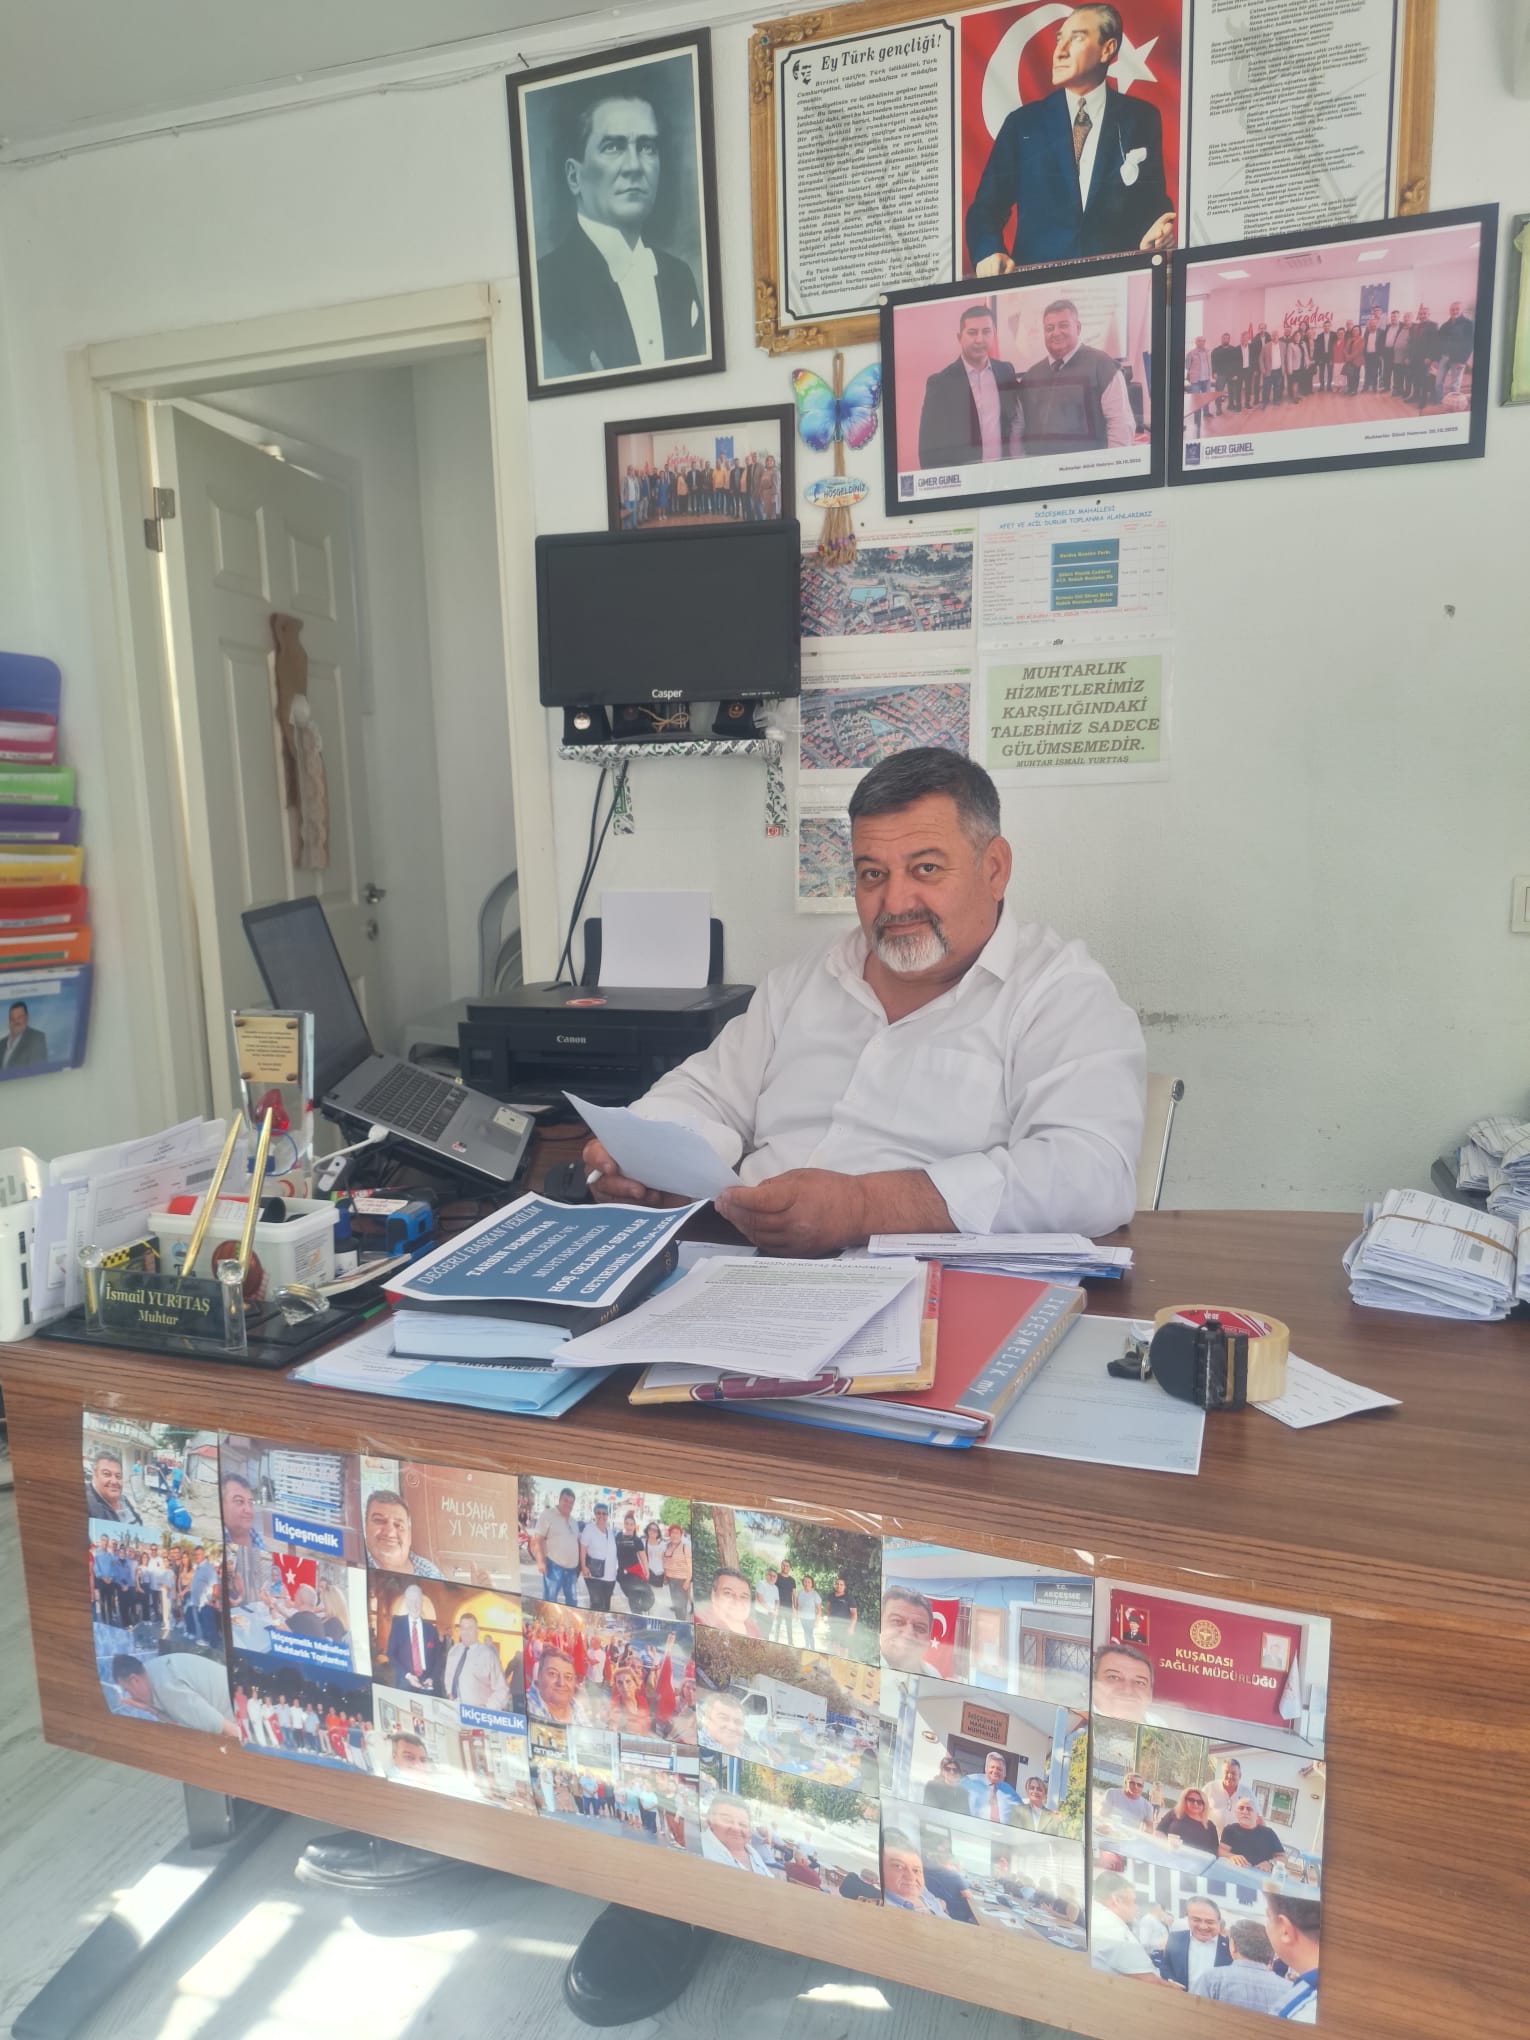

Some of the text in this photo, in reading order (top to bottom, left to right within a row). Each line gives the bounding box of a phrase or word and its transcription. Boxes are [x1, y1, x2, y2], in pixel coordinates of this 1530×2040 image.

[821, 34, 942, 72] Ey Türk gençliği!
[1022, 661, 1128, 680] MUHTARLIK
[651, 689, 683, 700] Casper
[1004, 677, 1146, 700] HİZMETLERİMİZ
[1002, 696, 1148, 720] KARŞILIĞINDAKİ
[991, 718, 1160, 738] TALEBİMİZ SADECE
[1002, 735, 1145, 757] GÜLÜMSEMEDİR.
[1016, 759, 1055, 768] MUHTAR
[556, 1034, 587, 1044] Canon
[417, 1251, 471, 1284] DEĞERLİ
[463, 1227, 508, 1255] BAŞKAN
[465, 1250, 511, 1276] TAHSİN
[547, 1218, 650, 1293] HOŞ GELDİNİZ SEFALAR
[106, 1282, 211, 1317] İsmail YURTTAŞ
[138, 1309, 179, 1326] Muhtar
[441, 1495, 496, 1520] HALISAHA
[274, 1517, 339, 1548] İkiçeşmelik
[448, 1519, 509, 1540] YI YAPTIR
[1175, 1647, 1234, 1668] KUŞADASI
[1159, 1657, 1277, 1689] SAĞLIK MÜDÜRLÜĞÜ
[461, 1709, 525, 1730] İKİÇEŞMELİK
